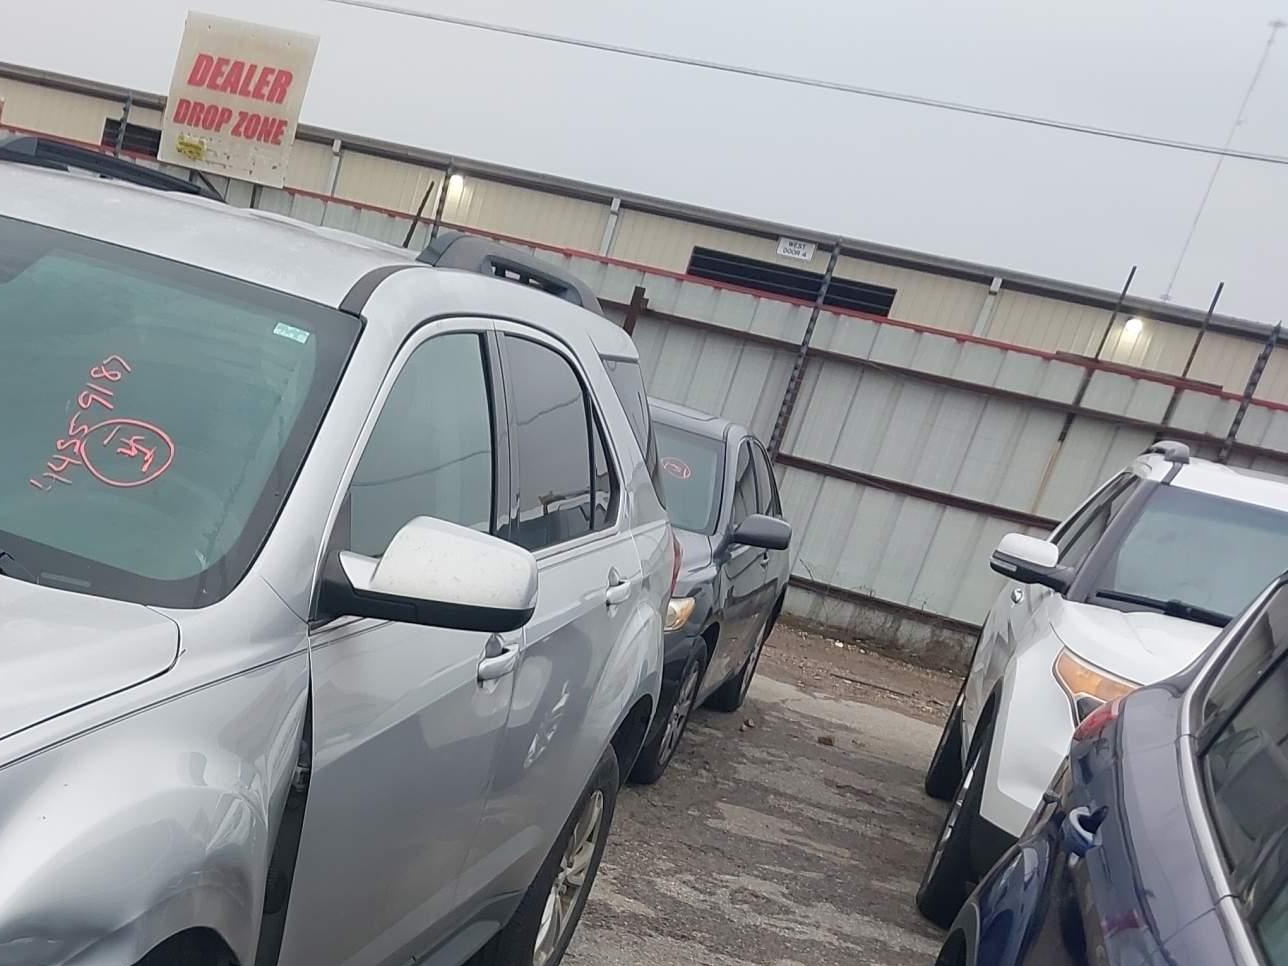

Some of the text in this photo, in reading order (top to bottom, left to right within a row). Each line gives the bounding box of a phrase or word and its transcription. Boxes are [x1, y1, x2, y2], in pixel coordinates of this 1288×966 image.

[187, 53, 294, 104] DEALER
[173, 98, 288, 145] DROP ZONE
[782, 247, 801, 256] DOOR
[788, 240, 806, 250] WEST
